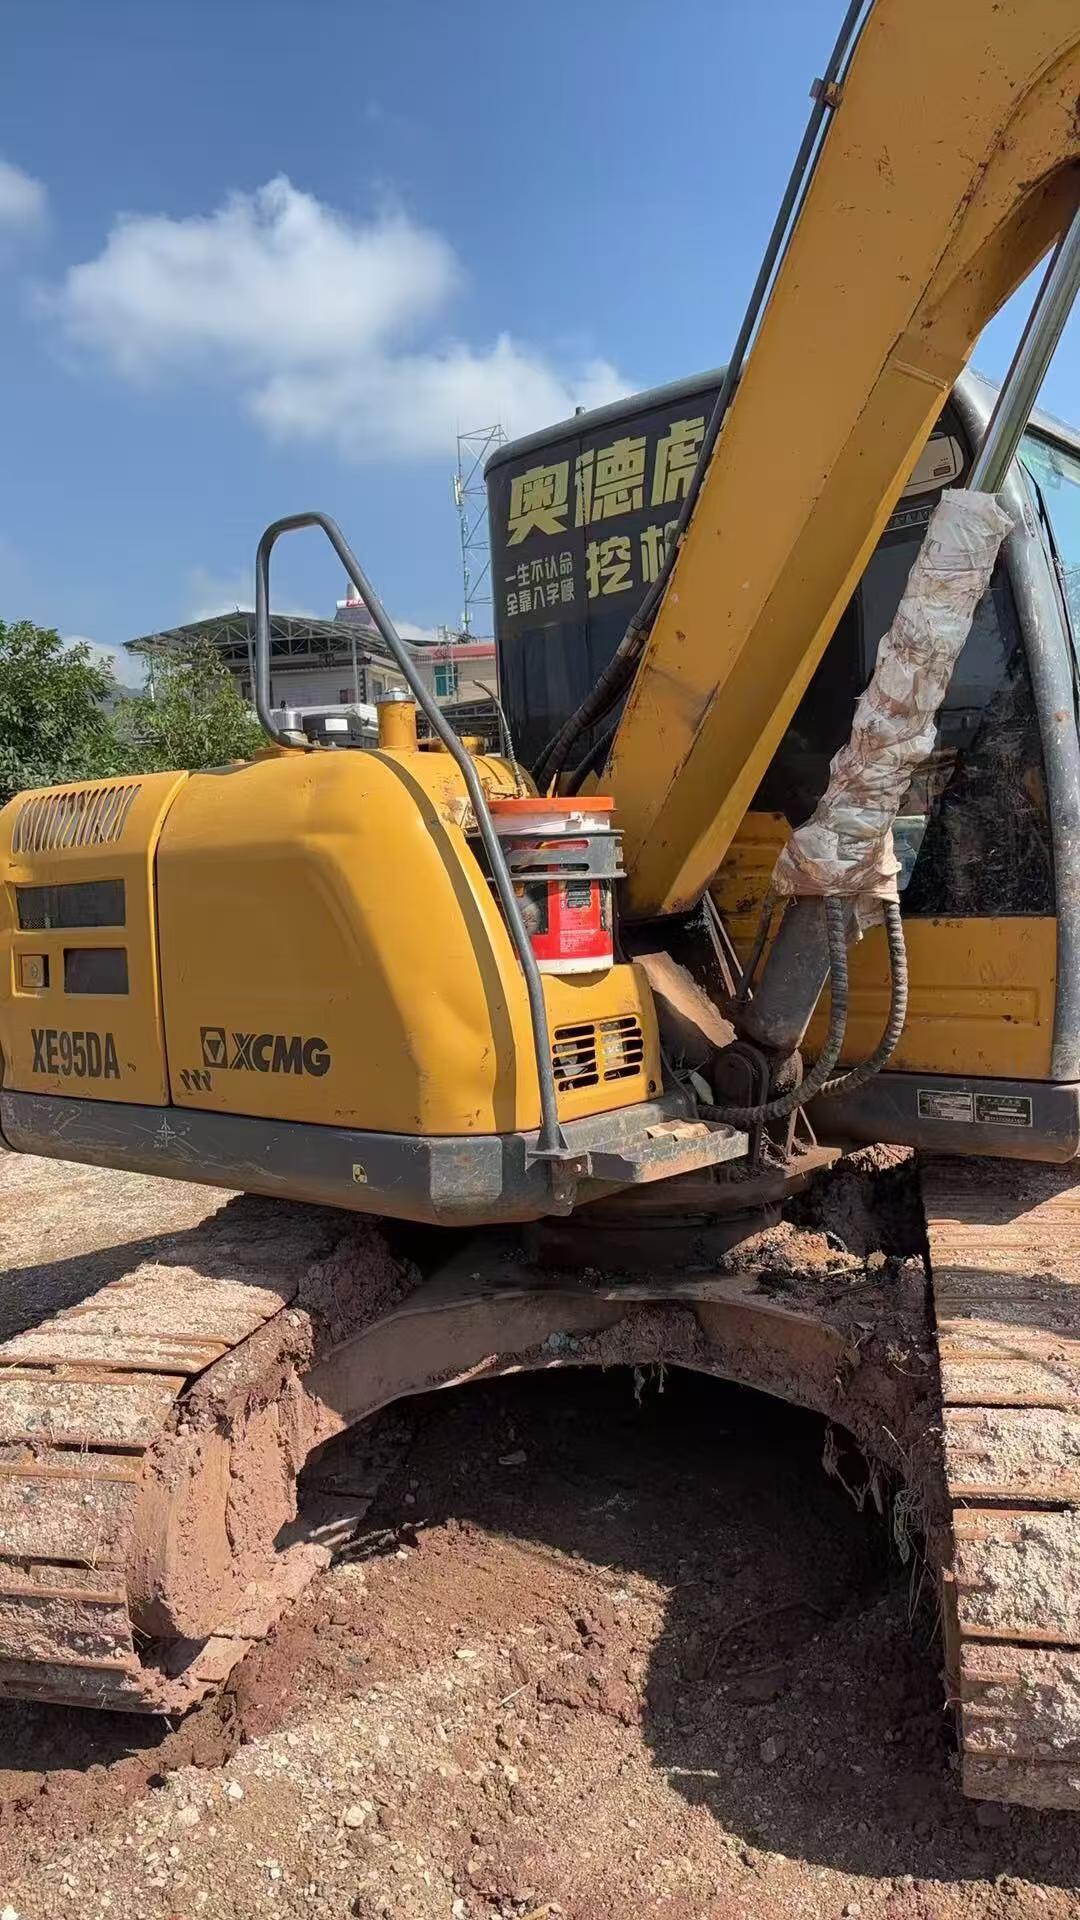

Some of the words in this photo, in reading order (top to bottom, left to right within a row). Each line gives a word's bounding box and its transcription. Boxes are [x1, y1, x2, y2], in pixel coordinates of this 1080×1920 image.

[506, 416, 704, 547] 奥德虎
[504, 551, 573, 587] 一生不认命
[506, 577, 575, 617] 全靠八字硬
[31, 1028, 121, 1079] XE95DA
[229, 1032, 331, 1077] XCMG
